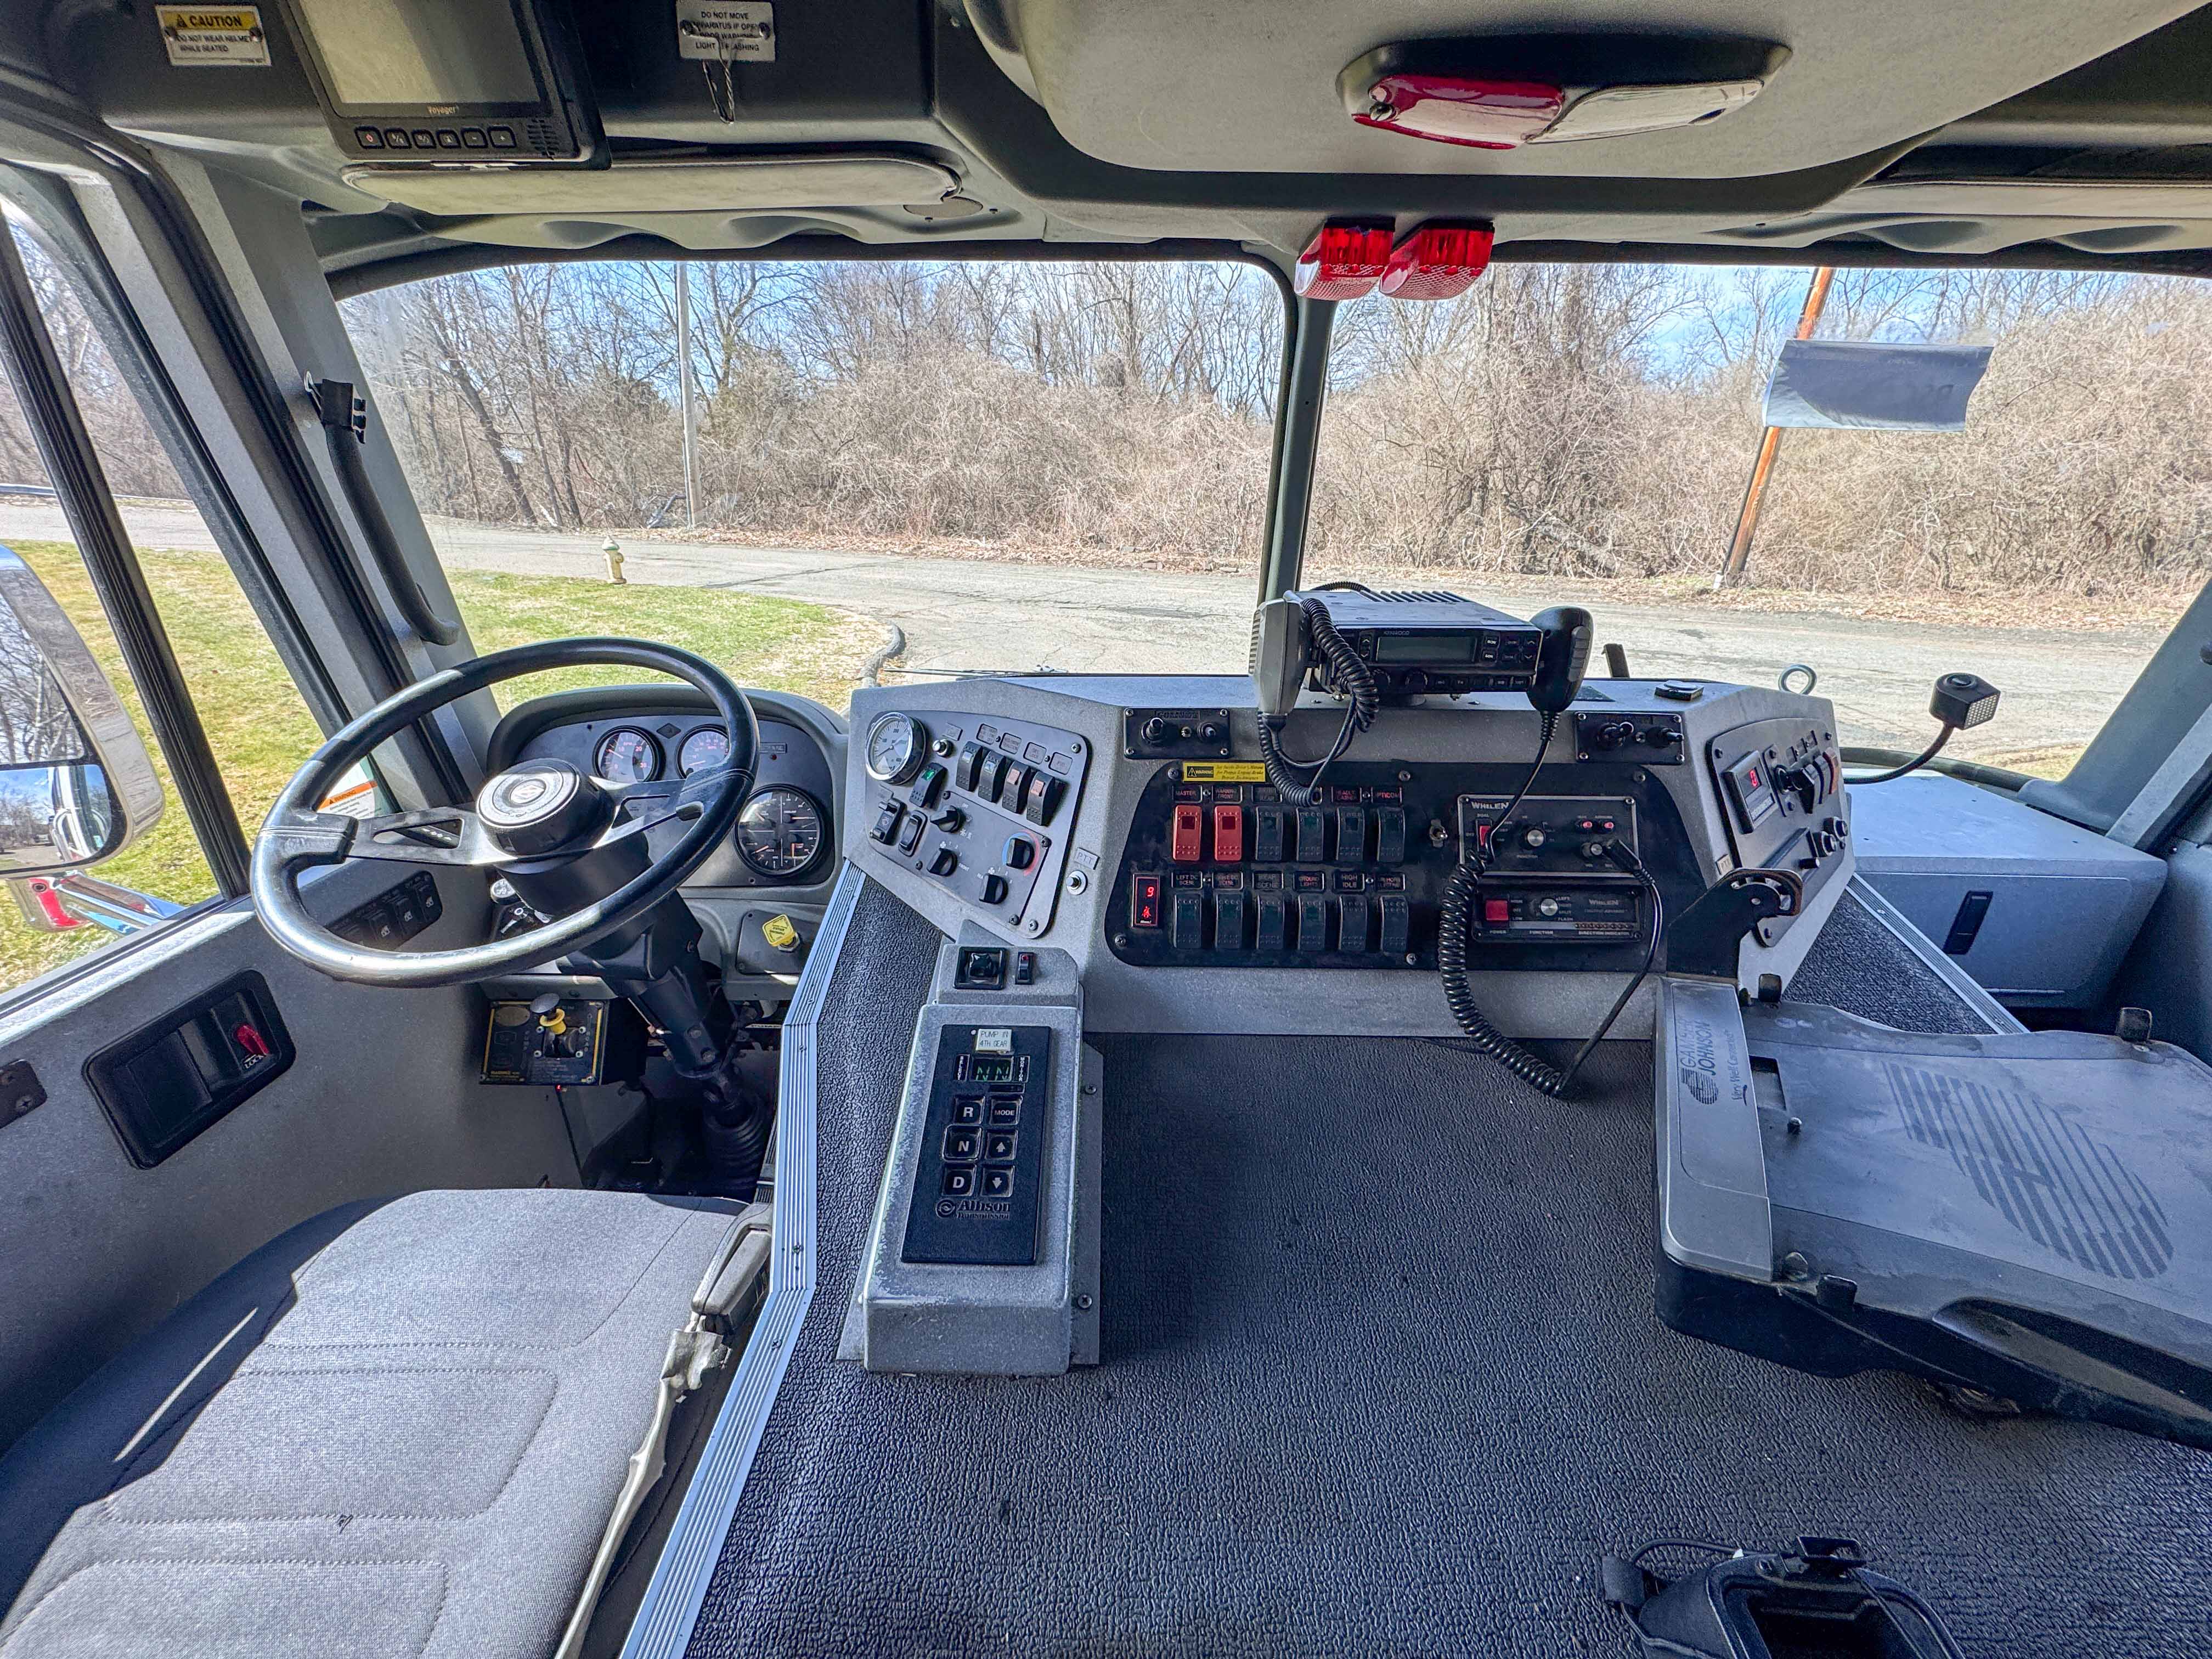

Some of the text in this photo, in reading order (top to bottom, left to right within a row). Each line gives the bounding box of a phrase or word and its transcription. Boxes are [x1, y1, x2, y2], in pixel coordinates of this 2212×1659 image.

[189, 16, 242, 26] CAUTION
[696, 42, 715, 50] LIGHT
[726, 43, 759, 51] FASHING
[1077, 853, 1093, 865] PTT
[1694, 1019, 1717, 1076] JOHNSON
[963, 1107, 974, 1118] R
[958, 1141, 970, 1152] N
[952, 1176, 965, 1188] D
[958, 1199, 1011, 1212] Allison
[957, 1212, 1010, 1220] Transmission
